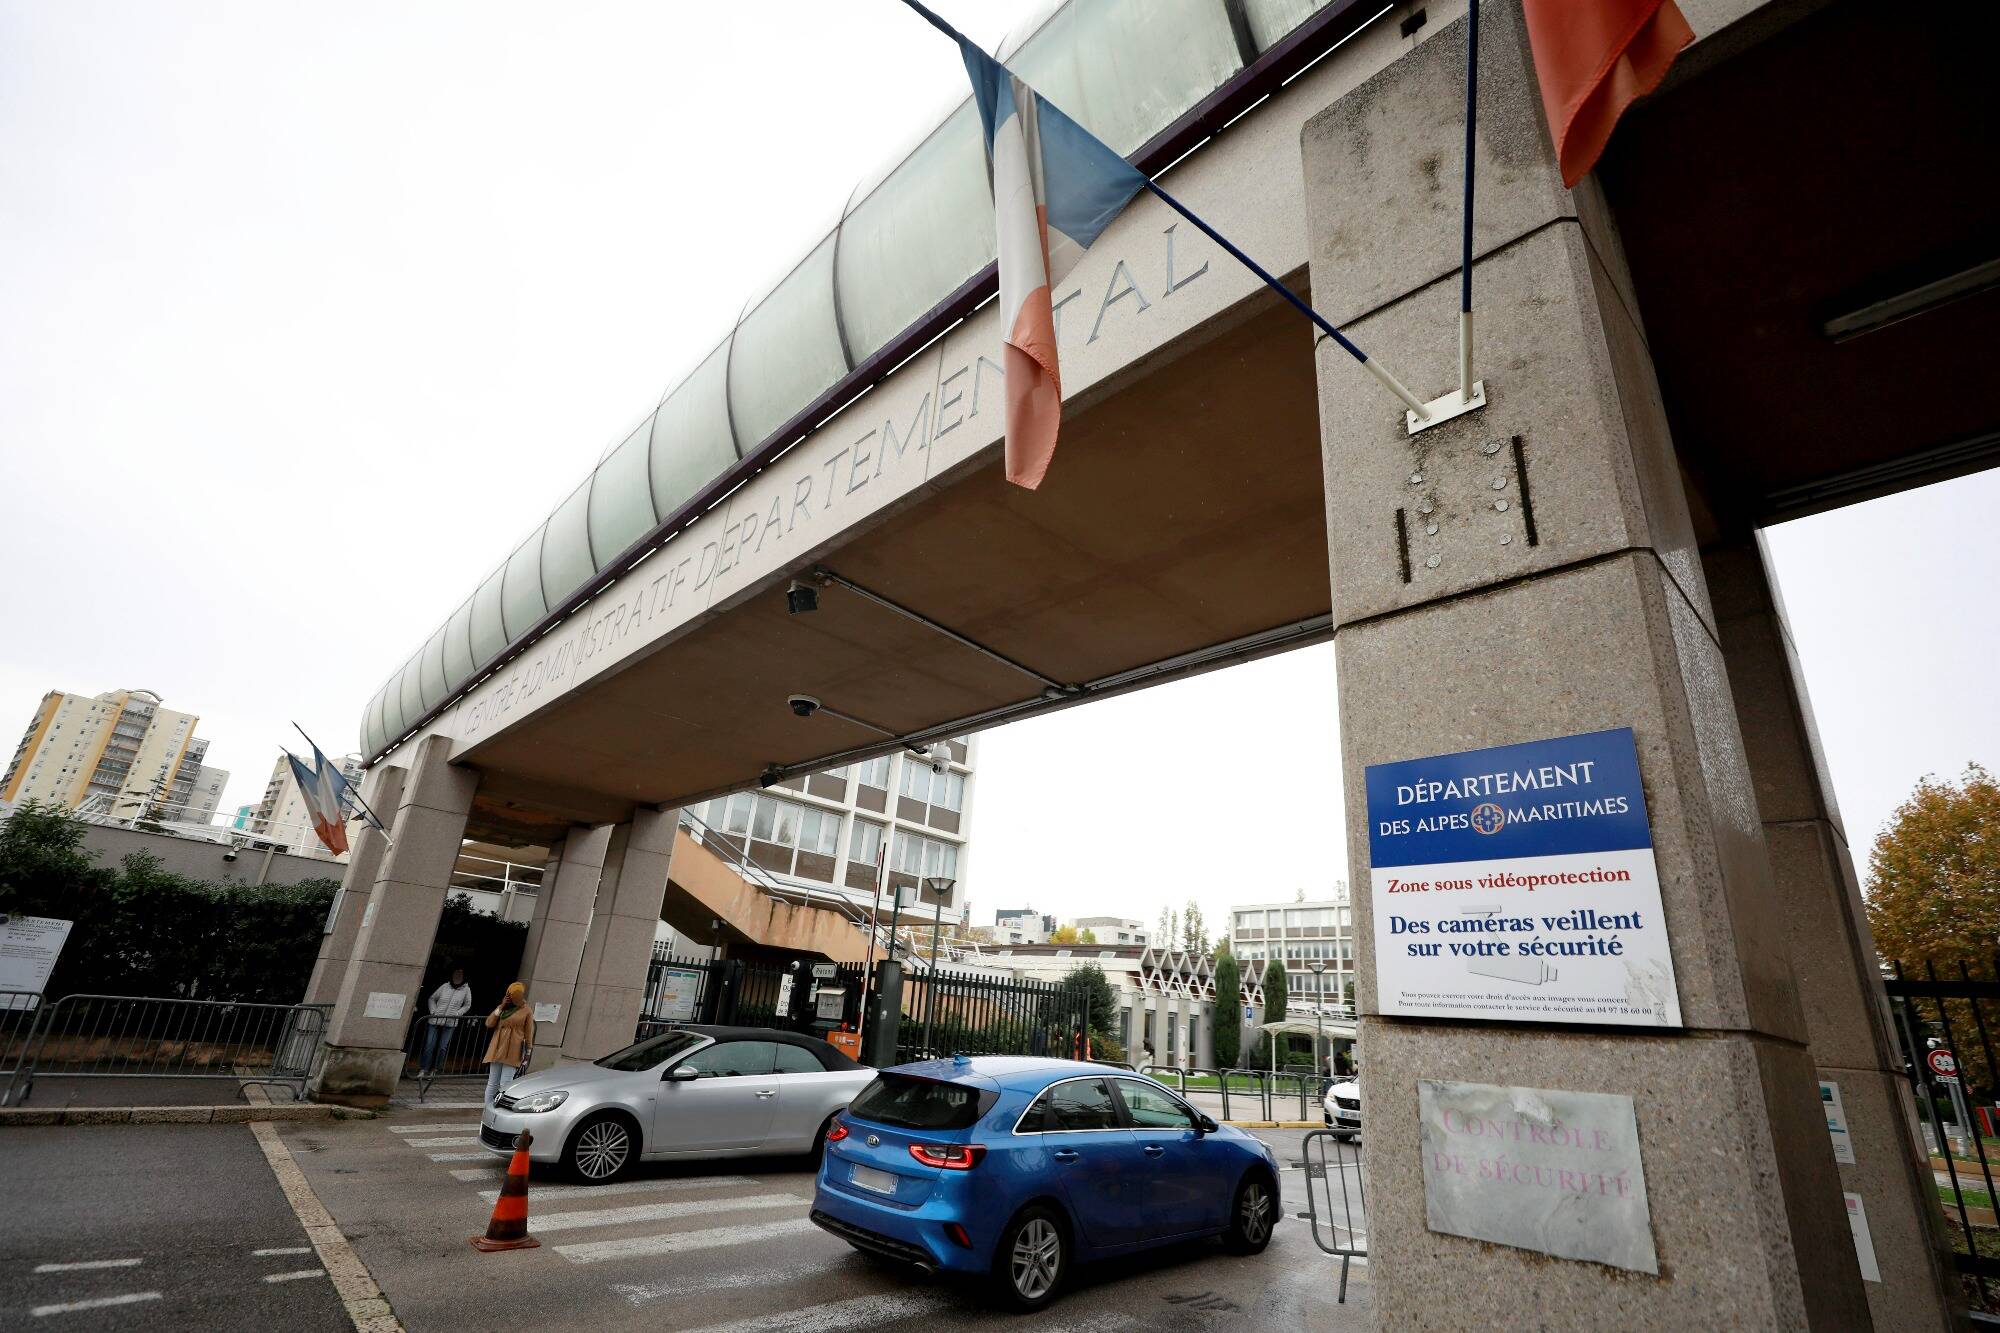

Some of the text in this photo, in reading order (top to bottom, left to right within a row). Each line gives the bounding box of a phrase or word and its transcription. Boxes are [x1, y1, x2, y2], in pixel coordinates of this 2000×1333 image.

[515, 557, 692, 705] ADMINISTRATIF
[1397, 761, 1595, 806] DÉPARTEMENT
[1380, 796, 1629, 837] DES ALPES MARITIMES
[1387, 866, 1631, 894] Zone sous vidéoprotection
[1390, 909, 1643, 935] Des caméras veillent
[1407, 934, 1624, 957] sur votre sécurité
[1432, 1001, 1472, 1009] information
[1553, 1005, 1584, 1013] sécurité
[1486, 993, 1503, 1001] droit
[1548, 995, 1576, 1004] images
[1434, 1152, 1467, 1175] DE
